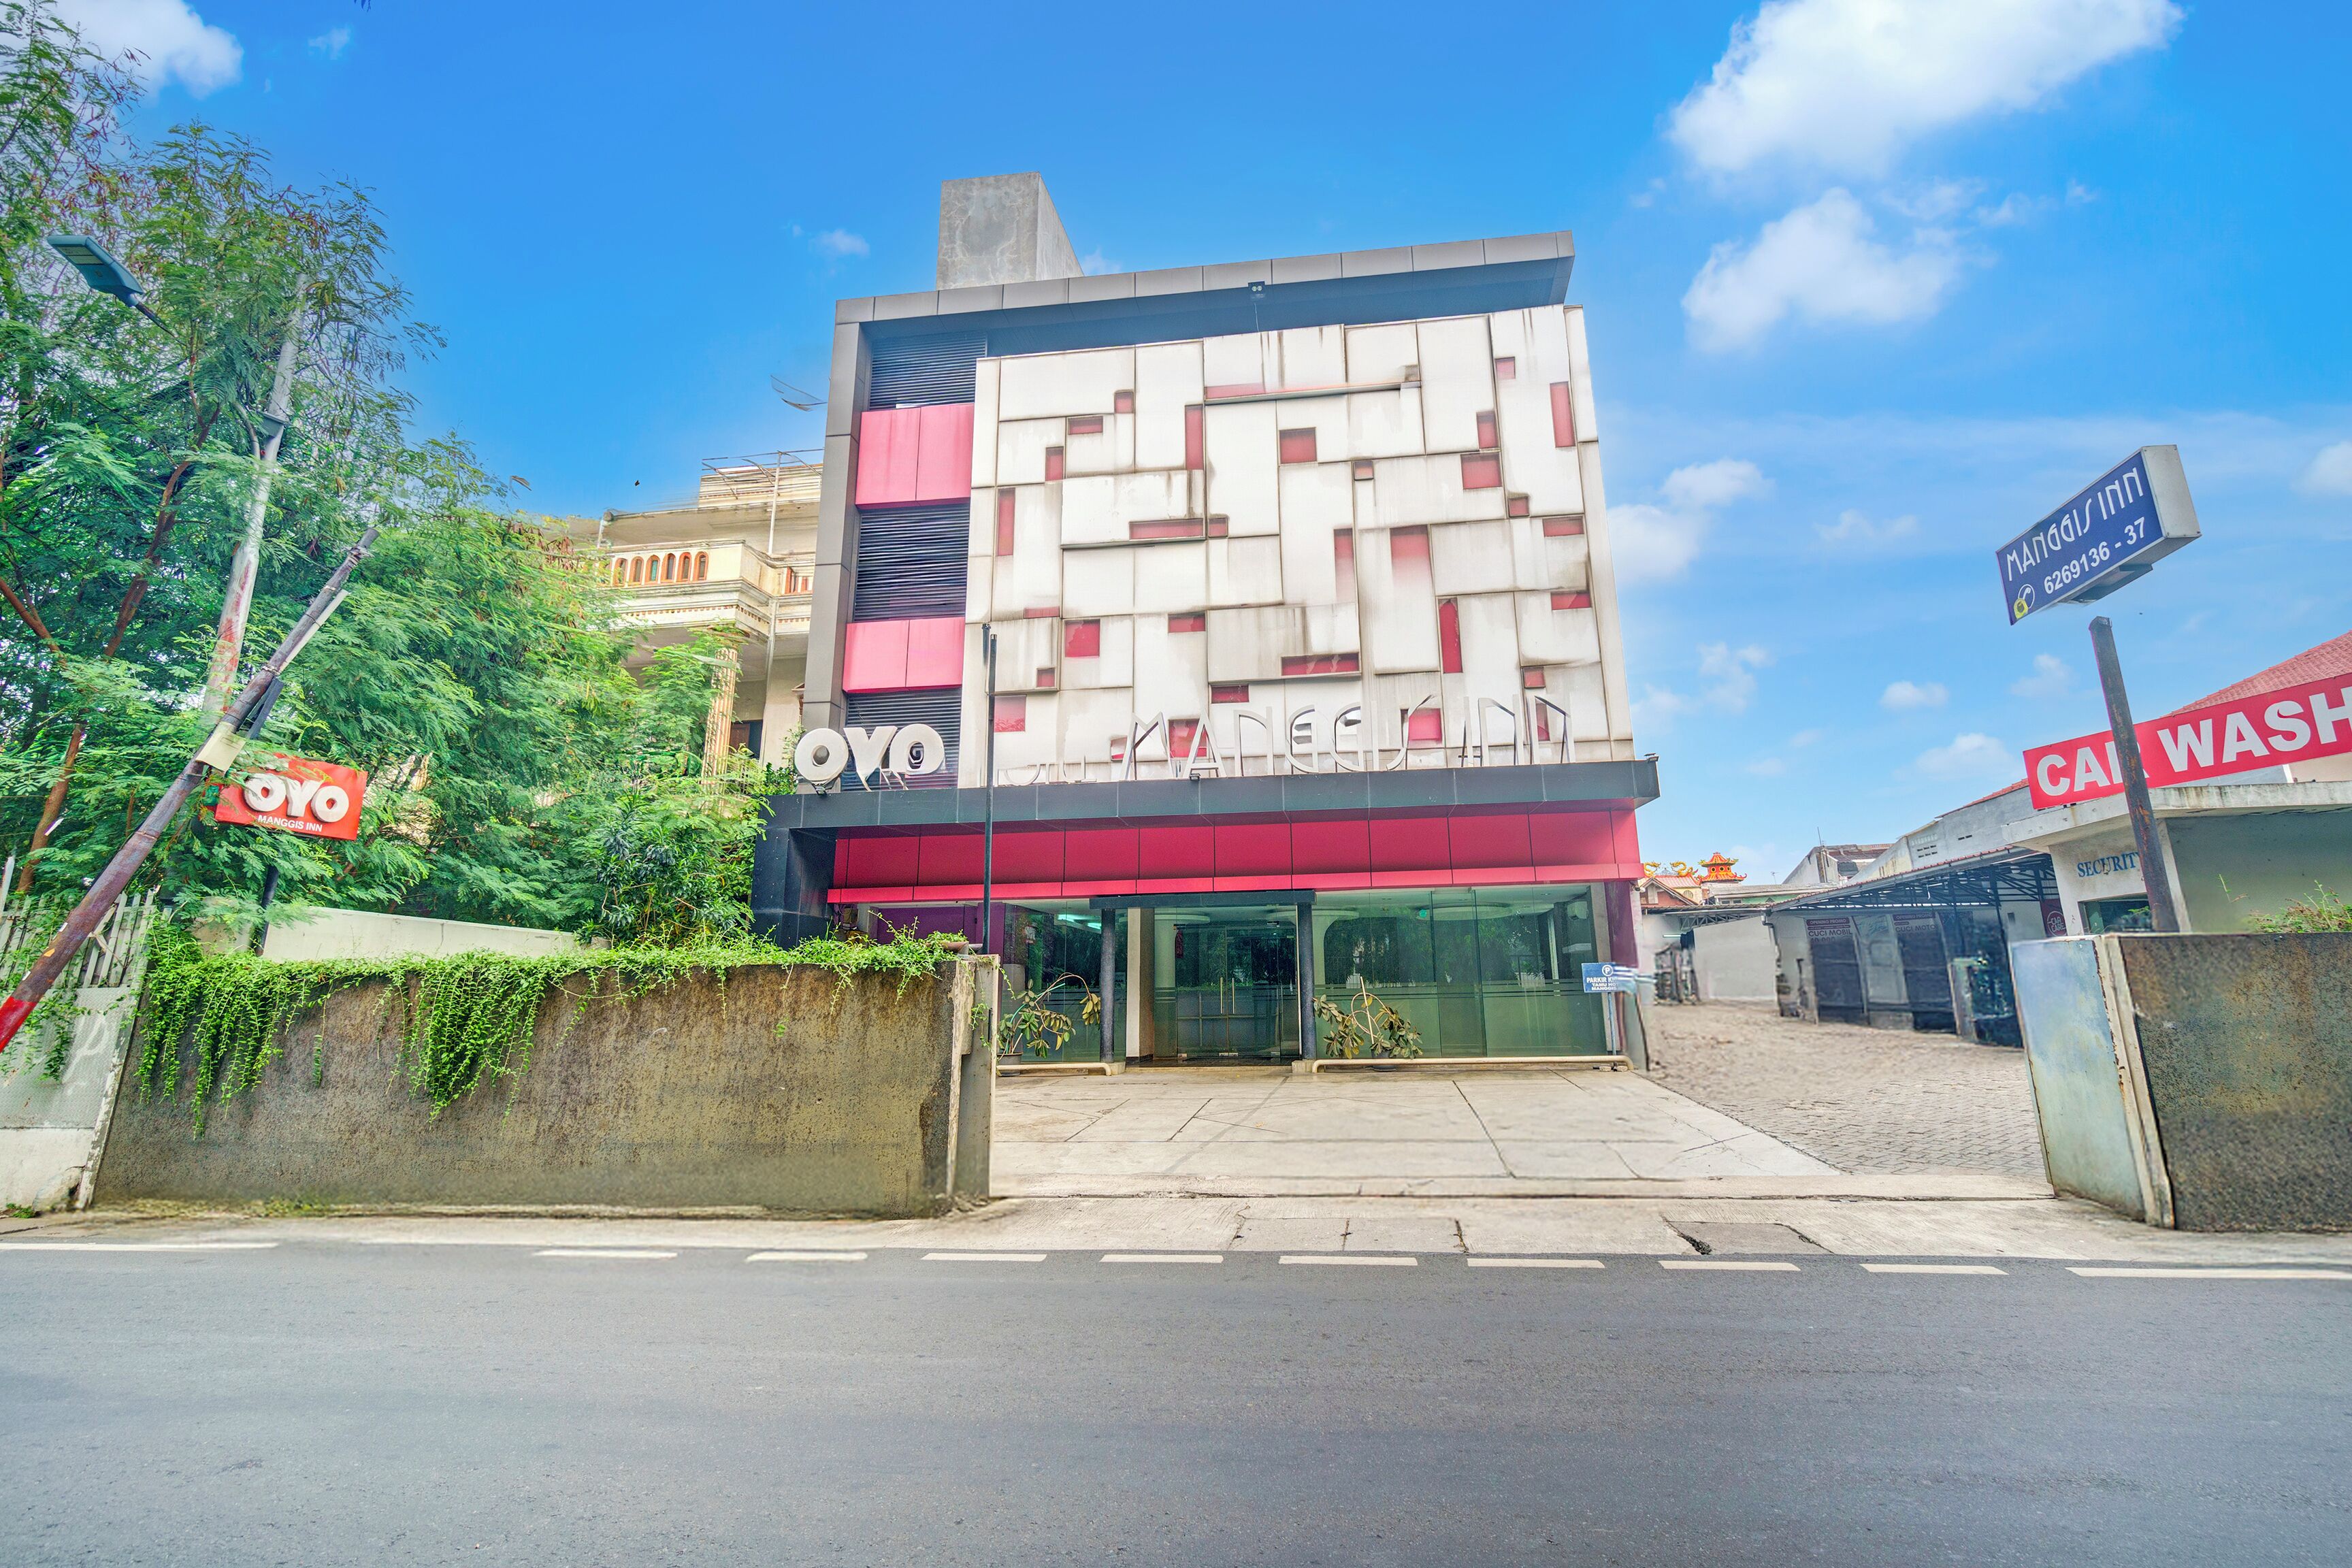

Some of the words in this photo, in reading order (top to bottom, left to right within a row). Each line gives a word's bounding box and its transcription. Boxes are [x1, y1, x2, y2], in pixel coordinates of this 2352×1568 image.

[2006, 498, 2092, 581] MANGGIS
[2097, 468, 2144, 520] INN
[2044, 541, 2110, 594] 6269136
[2124, 517, 2145, 544] 37
[2157, 687, 2352, 773] WASH
[244, 773, 350, 823] OYO
[257, 815, 304, 830] MANGGIS
[306, 822, 323, 832] INN
